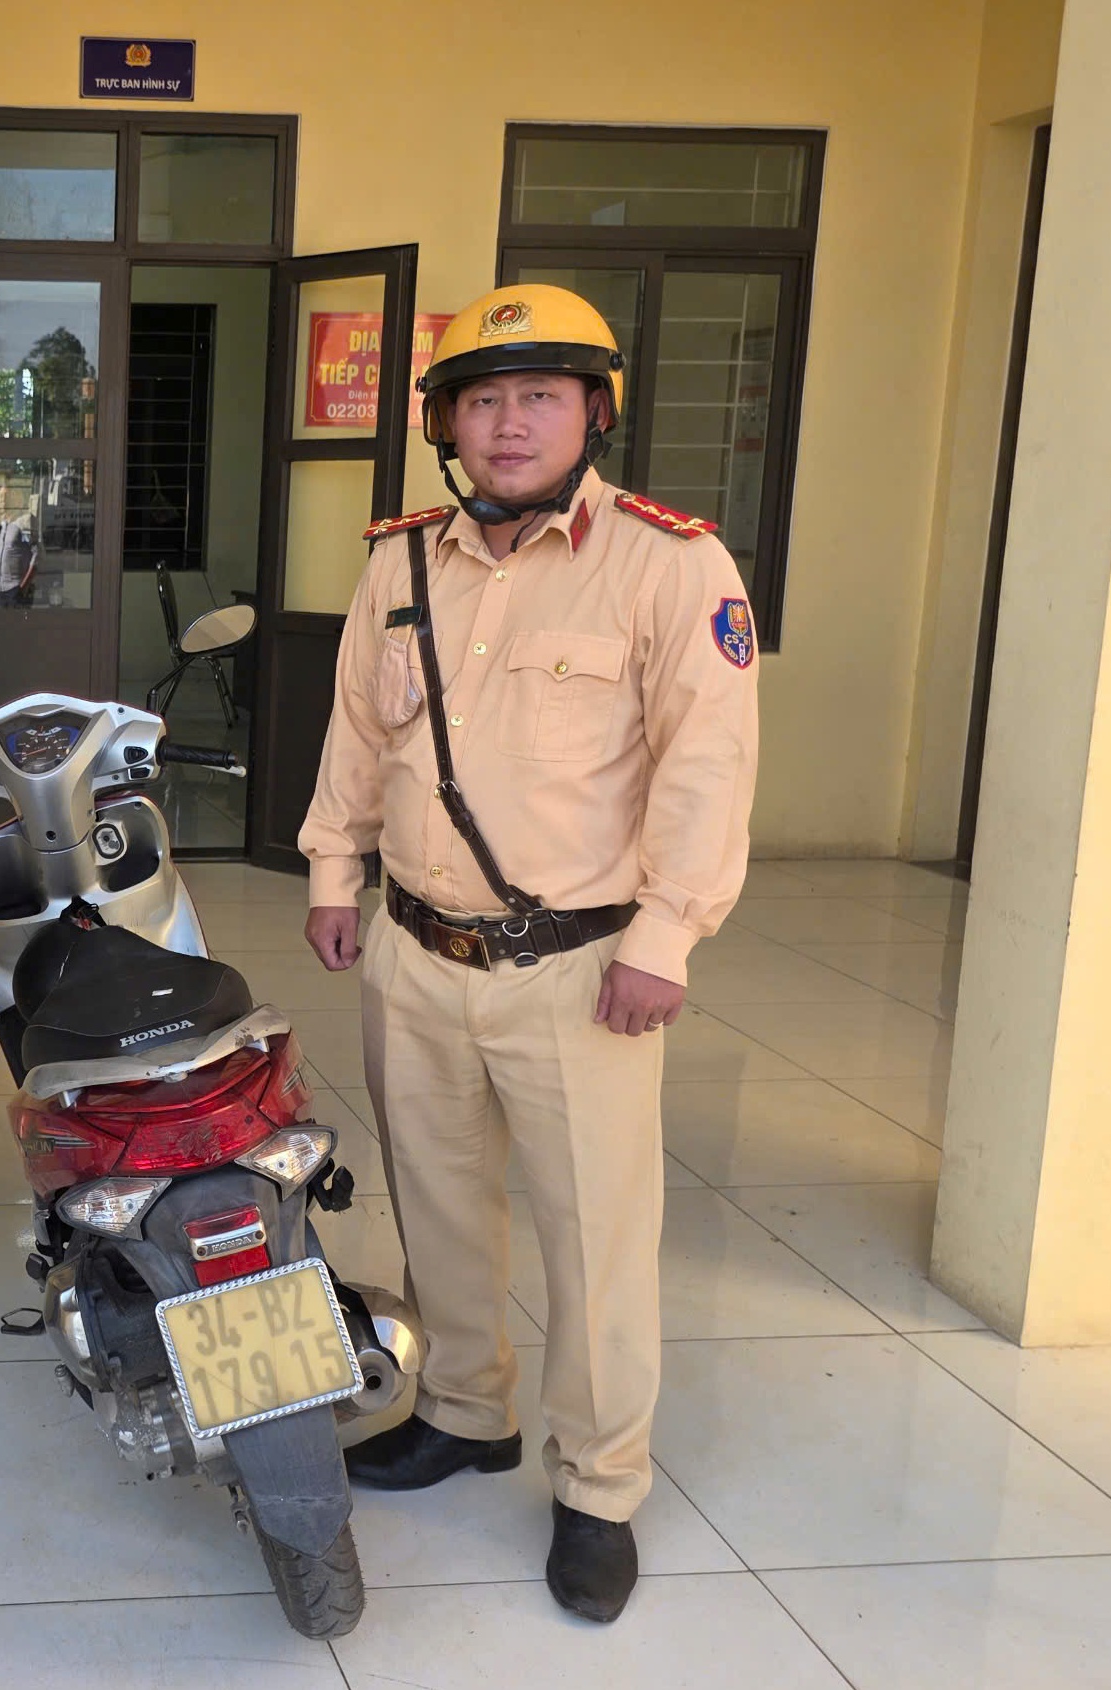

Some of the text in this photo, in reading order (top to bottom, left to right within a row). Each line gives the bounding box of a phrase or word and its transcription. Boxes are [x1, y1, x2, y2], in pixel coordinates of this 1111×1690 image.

[95, 77, 181, 92] TRỰC BAN HÌNH SỰ
[320, 357, 359, 386] TIẾP
[327, 403, 376, 419] 02203
[724, 633, 739, 644] CS
[119, 1019, 195, 1048] HONDA
[211, 1236, 252, 1253] HONDA
[186, 1278, 316, 1357] 34-B2
